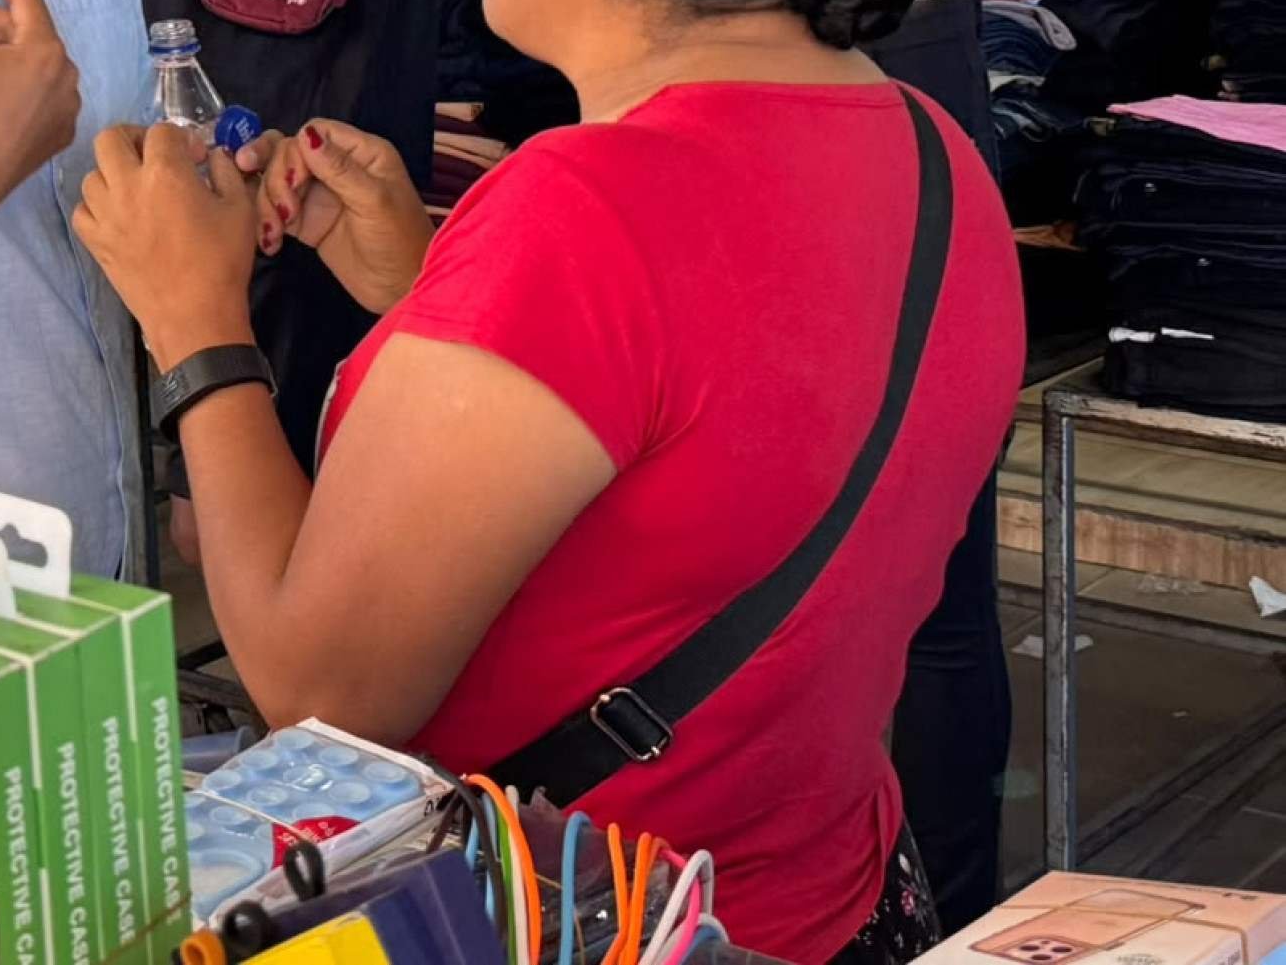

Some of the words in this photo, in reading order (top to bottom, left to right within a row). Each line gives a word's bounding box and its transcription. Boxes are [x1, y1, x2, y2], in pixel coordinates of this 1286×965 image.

[3, 765, 33, 930] PROTECTIVE
[57, 741, 85, 904] PROTECTIVE
[102, 715, 130, 876] PROTECTIVE
[116, 878, 136, 946] CASE
[151, 696, 176, 854] PROTECTIVE
